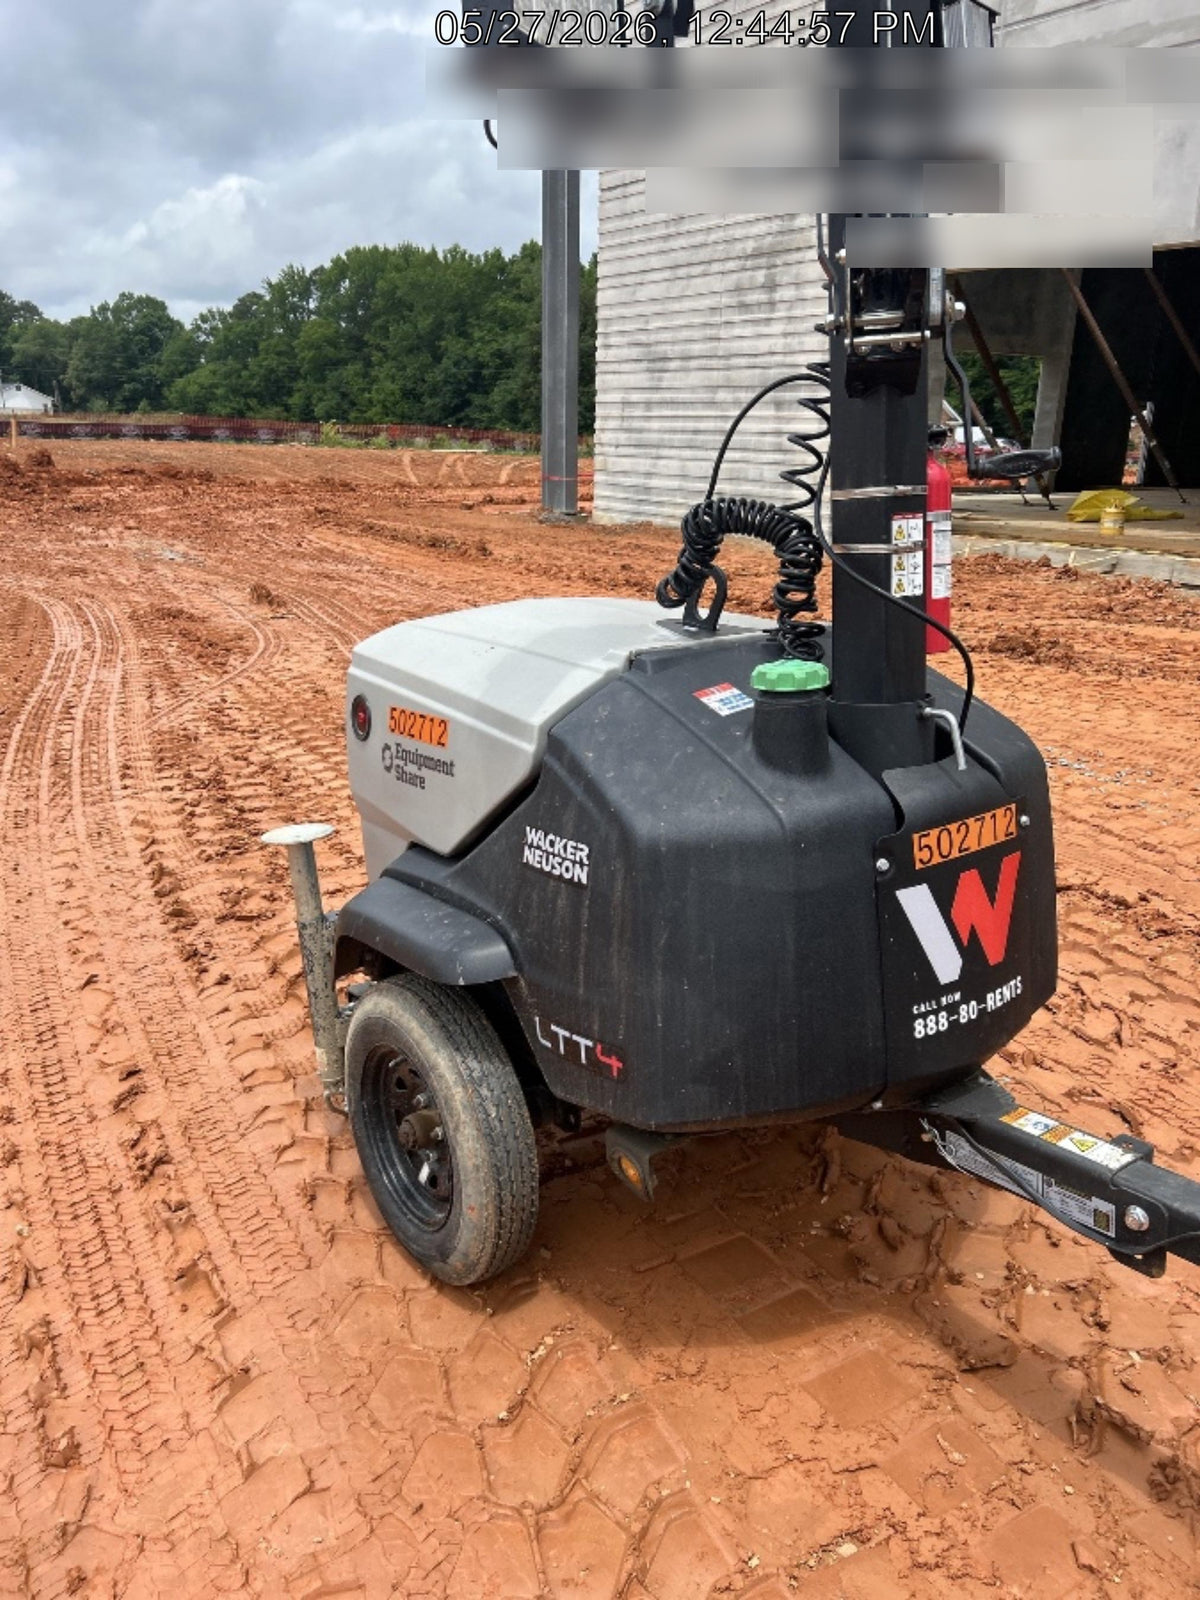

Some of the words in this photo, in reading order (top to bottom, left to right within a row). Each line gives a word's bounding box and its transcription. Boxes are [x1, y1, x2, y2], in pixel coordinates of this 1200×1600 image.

[389, 707, 447, 747] 502712
[394, 742, 455, 777] Equipment
[394, 763, 426, 790] Share
[525, 826, 589, 865] WACKER
[917, 806, 1015, 866] 502712
[522, 845, 589, 885] NEUSON
[912, 1002, 938, 1014] CALL
[940, 991, 962, 1007] NOW
[913, 975, 1023, 1039] 888-80-RENTS
[534, 1016, 623, 1077] LTT4
